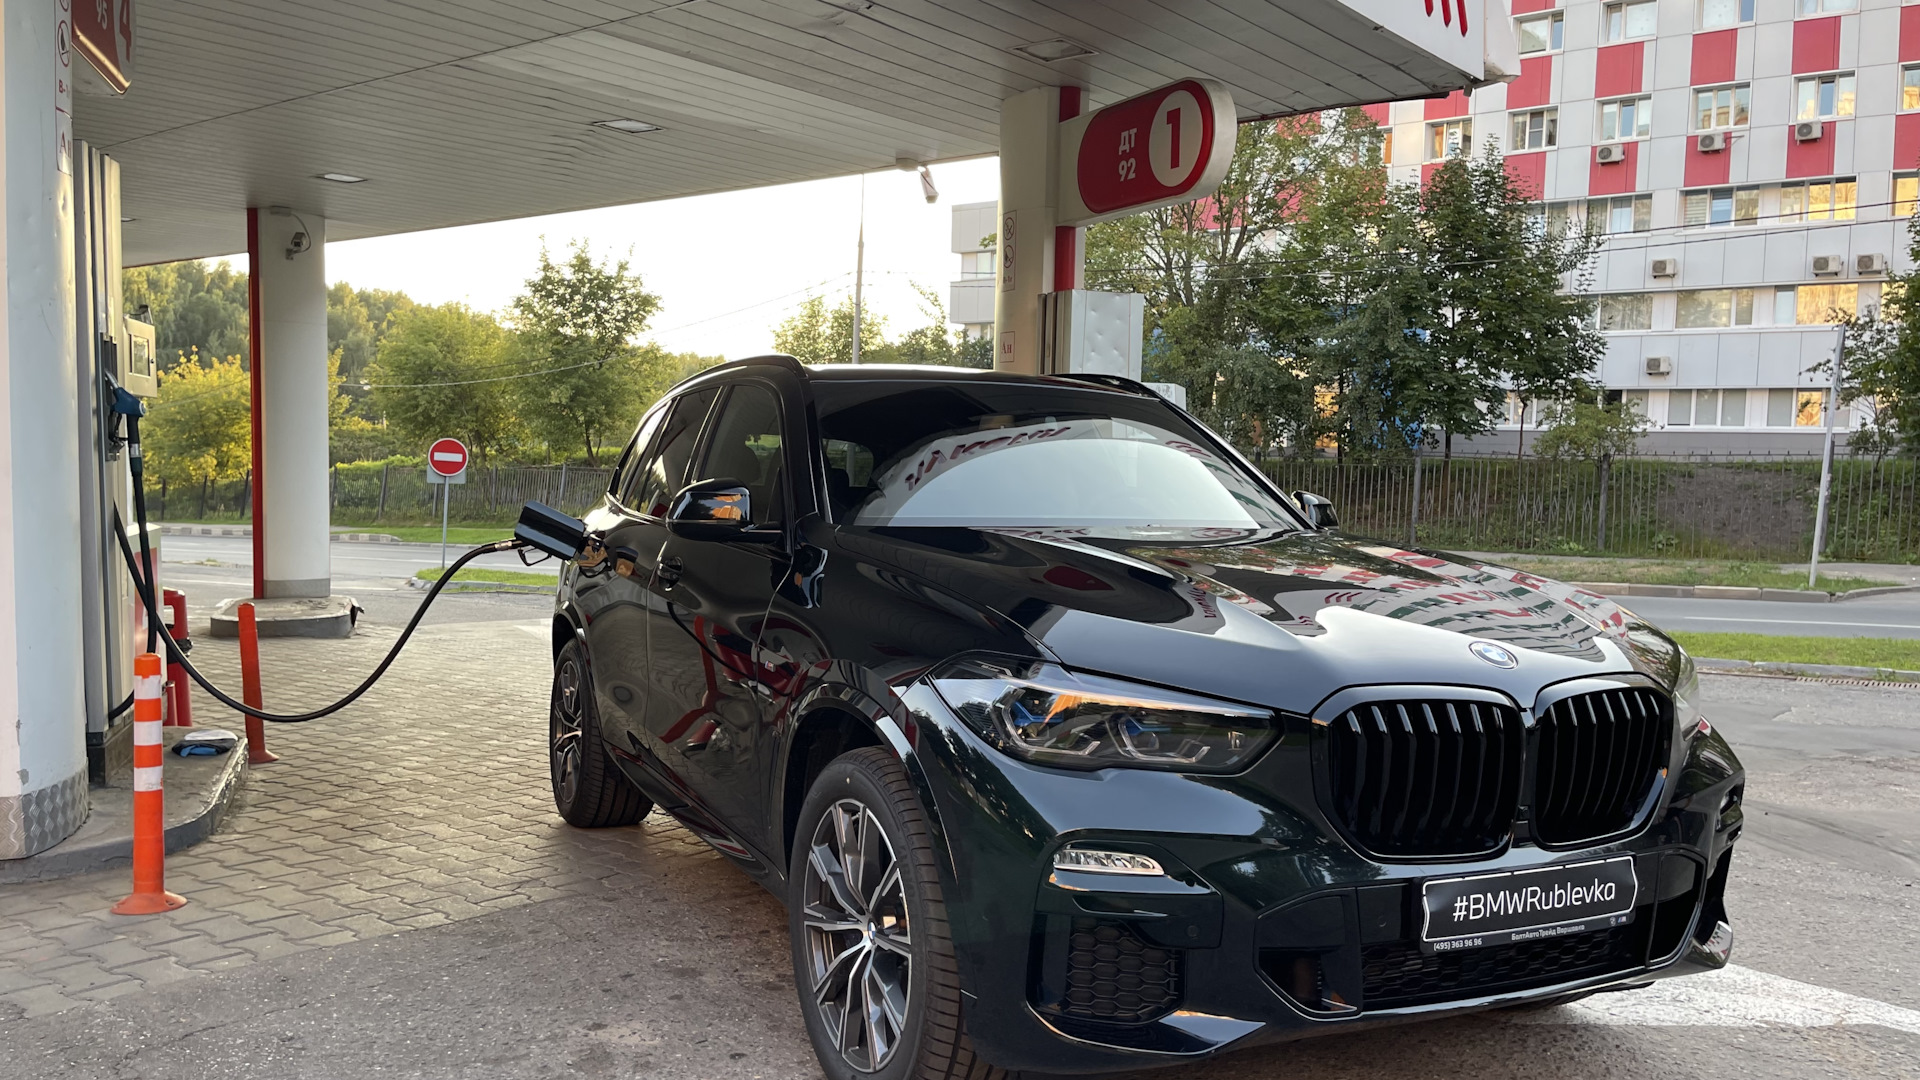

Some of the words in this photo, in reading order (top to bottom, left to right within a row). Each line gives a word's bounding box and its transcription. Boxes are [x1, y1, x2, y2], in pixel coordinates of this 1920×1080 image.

[96, 0, 108, 30] 95
[119, 0, 132, 63] 4
[1118, 127, 1138, 156] ДТ
[1166, 107, 1181, 169] 1
[1118, 157, 1137, 182] 92
[1452, 878, 1616, 922] #BMWRublevka
[1433, 942, 1451, 951] (495)
[1451, 940, 1464, 949] 363
[1464, 939, 1473, 947] 96
[1473, 938, 1482, 946] 96
